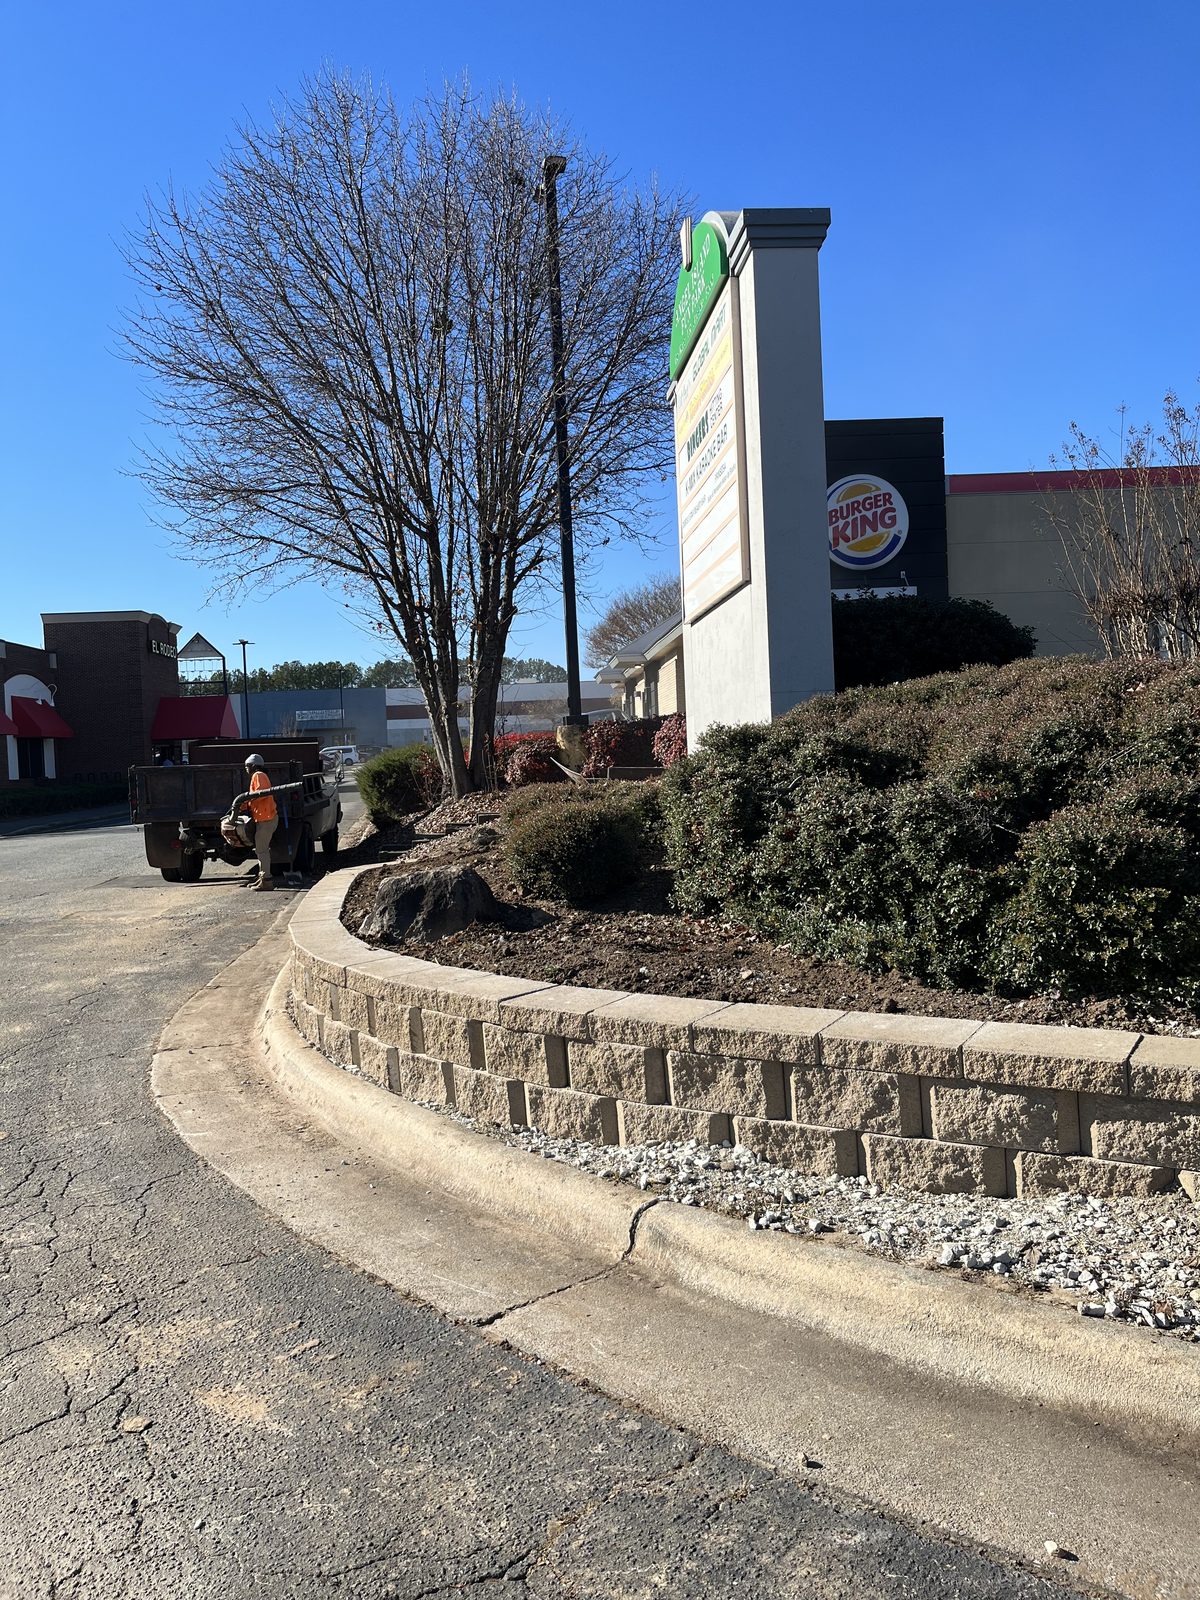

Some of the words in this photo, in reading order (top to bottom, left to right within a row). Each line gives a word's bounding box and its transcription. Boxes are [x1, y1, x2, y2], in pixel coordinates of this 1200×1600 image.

[691, 233, 710, 291] ISLAND
[711, 302, 726, 347] MART
[695, 439, 716, 479] KARAOKE
[717, 423, 727, 452] BAR
[828, 492, 893, 526] BURGER
[832, 507, 897, 549] KING
[152, 640, 159, 653] EL
[160, 642, 177, 659] RODEO
